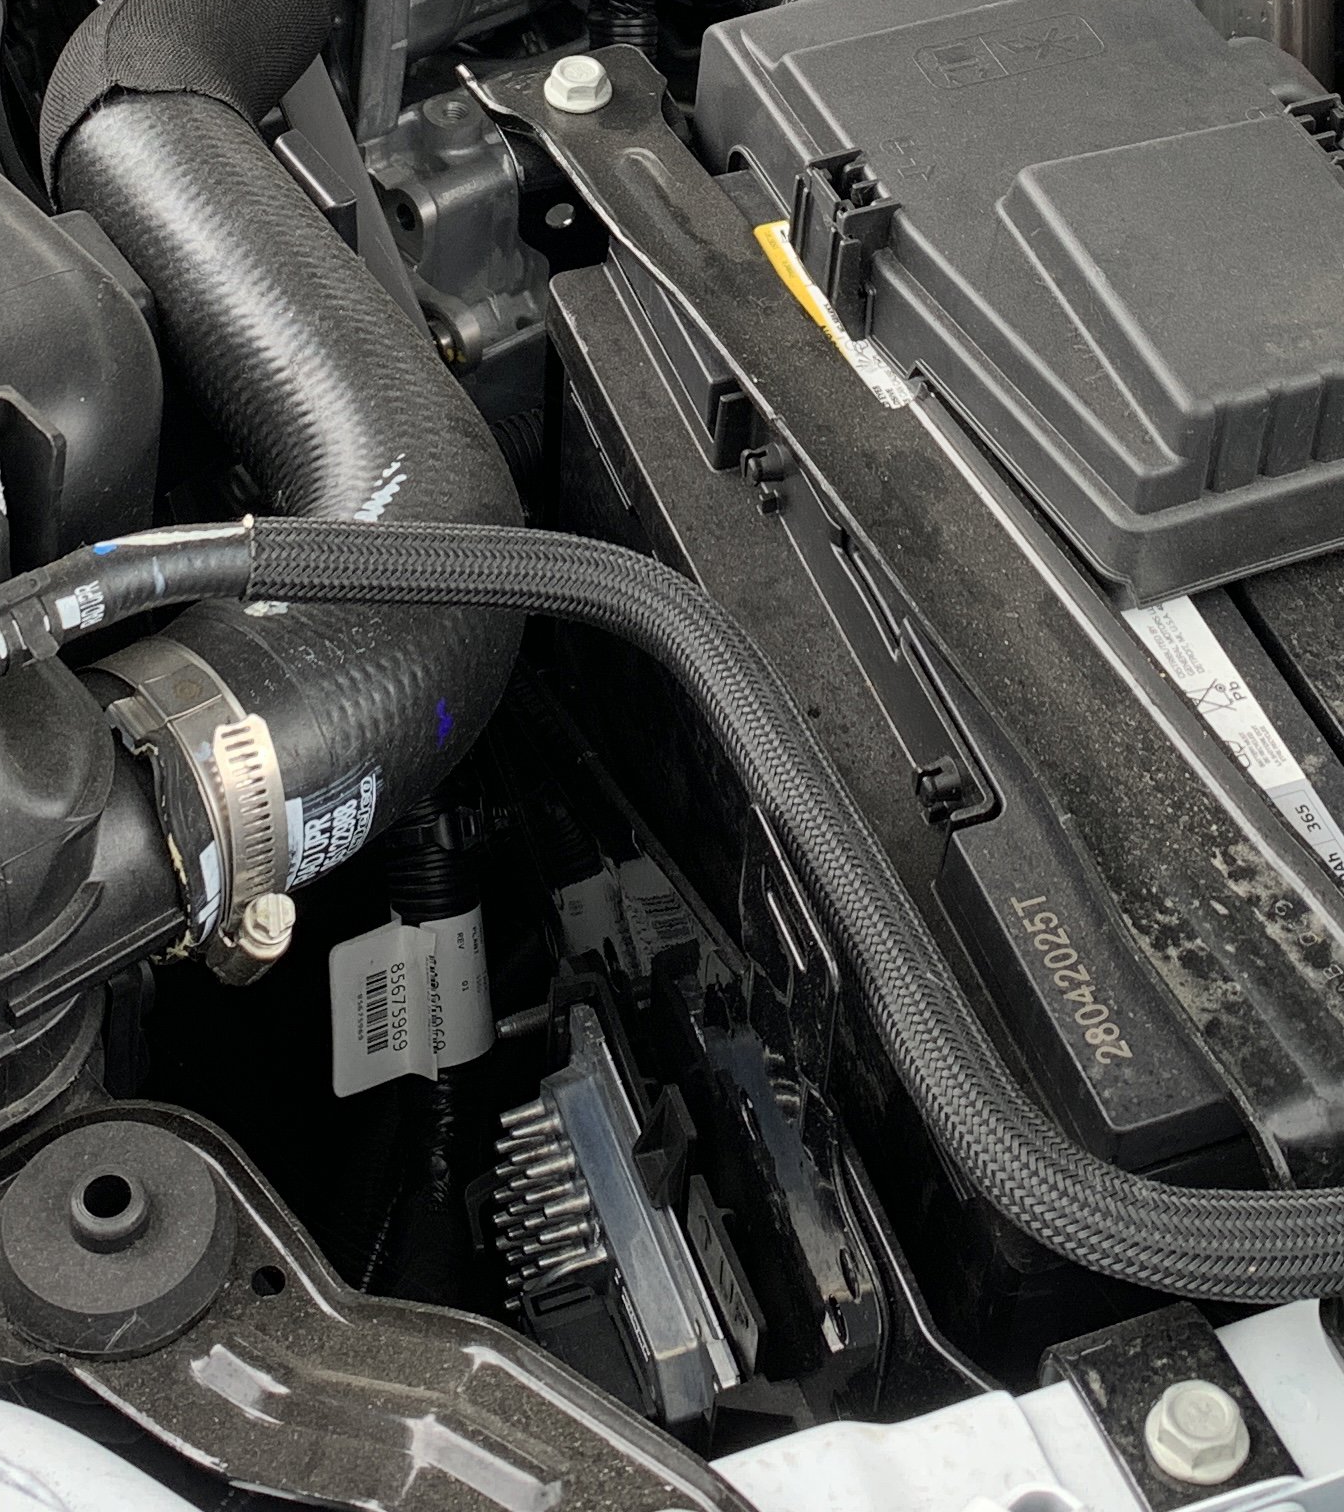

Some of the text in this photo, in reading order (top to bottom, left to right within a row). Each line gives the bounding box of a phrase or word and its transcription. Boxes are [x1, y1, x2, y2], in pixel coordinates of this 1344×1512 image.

[1228, 681, 1247, 702] Pb
[305, 812, 332, 854] UPR
[1294, 804, 1322, 833] 365
[456, 931, 465, 950] REV
[1010, 895, 1134, 1065] 28042025T
[390, 961, 408, 1052] 85675969
